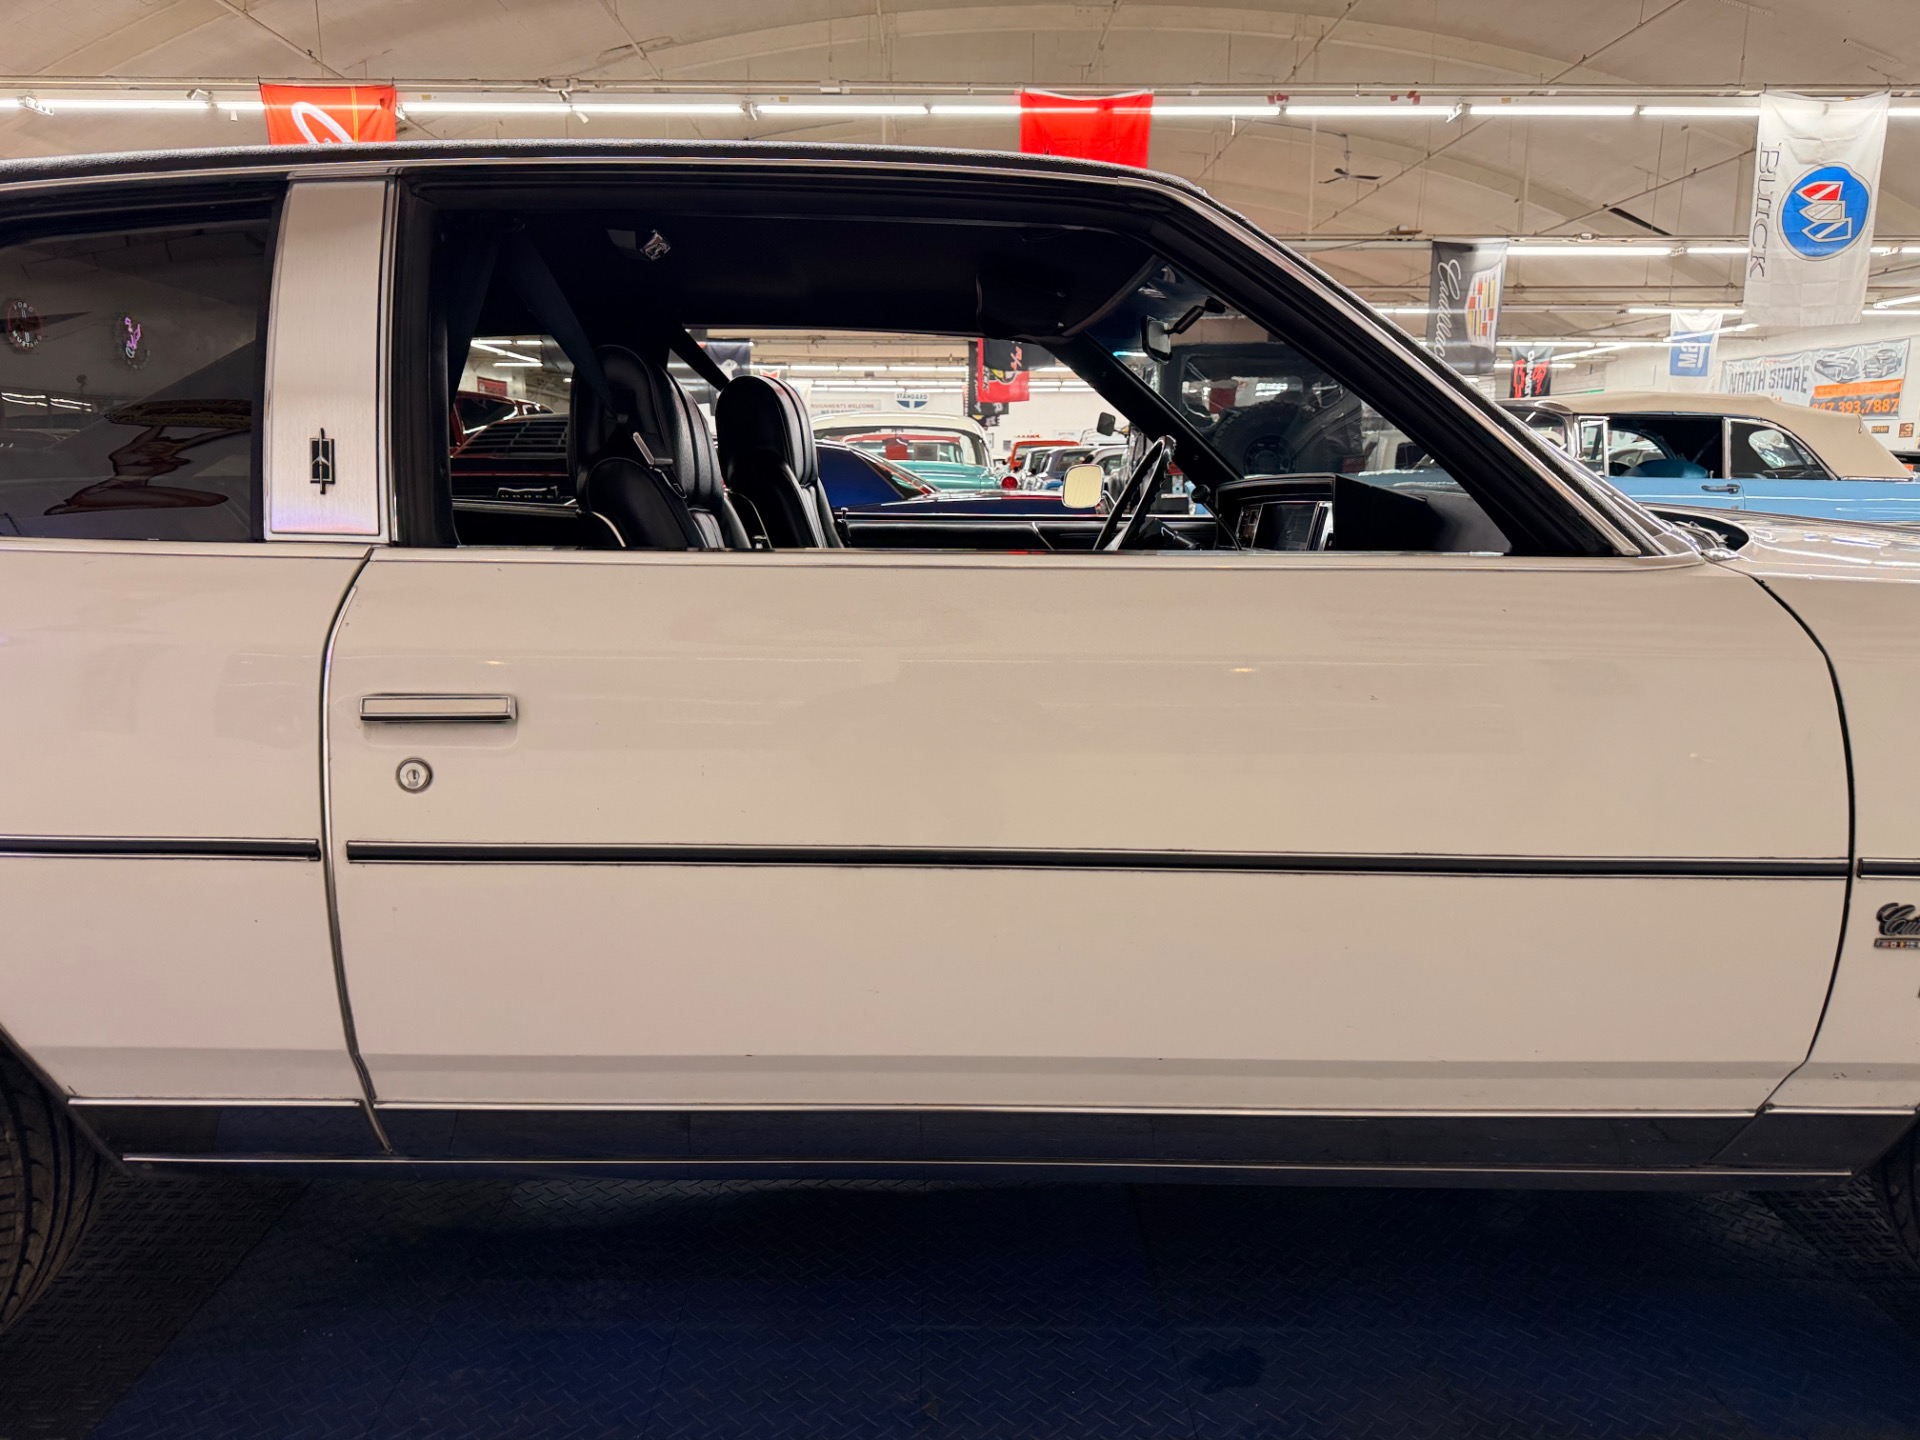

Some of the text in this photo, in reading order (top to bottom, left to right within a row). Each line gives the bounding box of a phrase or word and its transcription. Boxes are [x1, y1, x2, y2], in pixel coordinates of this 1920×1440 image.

[1750, 142, 1781, 277] BUICK
[1434, 259, 1461, 358] Cadillac
[1728, 369, 1766, 394] NORTH
[1768, 365, 1810, 393] SHORE
